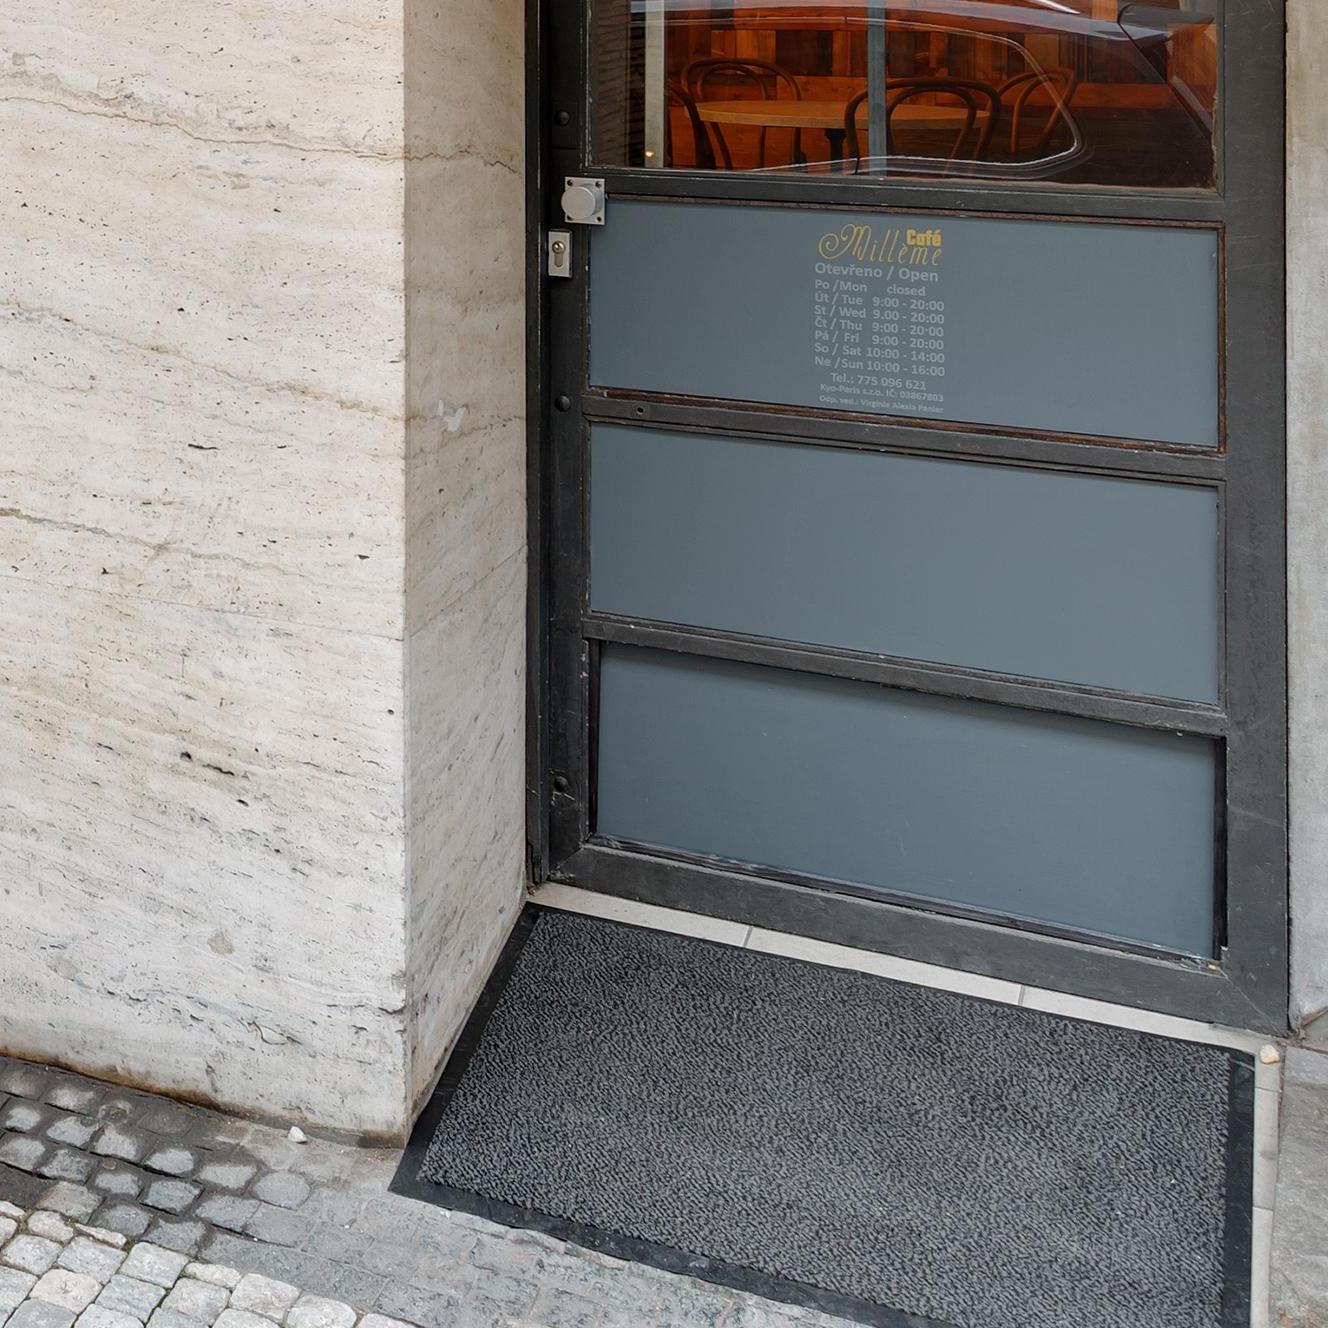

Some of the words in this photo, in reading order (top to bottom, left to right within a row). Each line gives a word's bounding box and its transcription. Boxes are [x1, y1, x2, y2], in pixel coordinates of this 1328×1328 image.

[819, 224, 942, 266] Millème
[906, 229, 942, 247] Café
[815, 262, 883, 278] Otevřeno
[898, 268, 939, 283] Open
[815, 279, 830, 290] Po
[887, 284, 926, 296] closed
[815, 290, 830, 303] Út
[841, 294, 864, 305] Tue
[872, 296, 899, 308] 9:00
[910, 299, 944, 311] 20:00
[814, 305, 826, 316] St
[839, 307, 866, 318] Wed
[910, 312, 944, 324] 20:00
[815, 316, 828, 328] Čt
[840, 319, 863, 331] Thu
[872, 322, 898, 334] 9:00
[815, 330, 829, 341] Pá
[844, 333, 860, 343] Fri
[872, 334, 899, 346] 9:00
[910, 338, 944, 350] 20:00
[815, 342, 829, 353] So
[843, 346, 862, 356] Sat
[866, 347, 900, 359] 10:00
[911, 351, 945, 363] 14:00
[815, 356, 831, 367] Ne
[867, 360, 900, 373] 10:00
[911, 365, 946, 377] 16:00
[830, 372, 854, 384] Tel.:
[857, 374, 878, 386] 775
[881, 377, 903, 389] 096
[905, 379, 927, 391] 621
